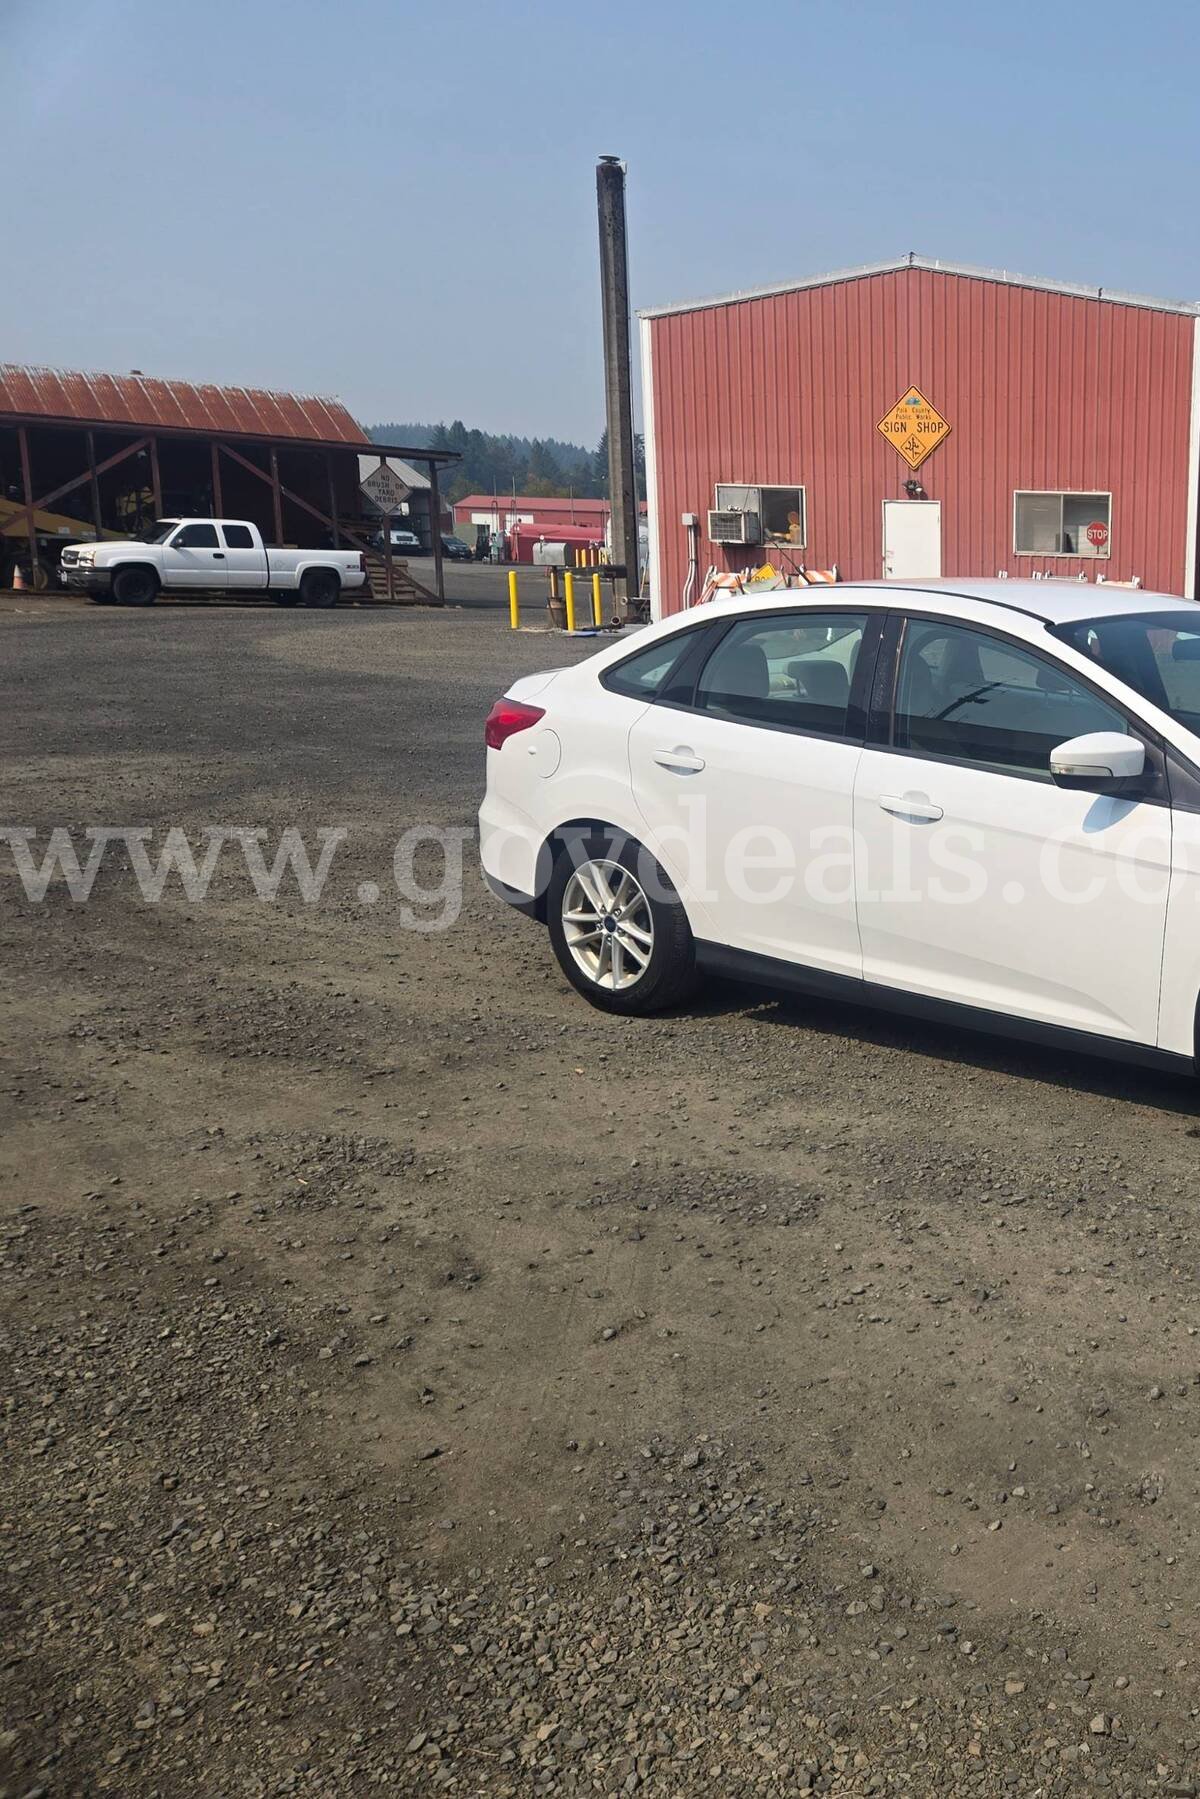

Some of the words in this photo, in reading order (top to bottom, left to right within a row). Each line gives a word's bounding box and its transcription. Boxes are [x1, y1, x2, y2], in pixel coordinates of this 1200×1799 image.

[883, 421, 907, 433] SIGN
[917, 421, 944, 433] SHOP
[1087, 529, 1108, 540] STOP
